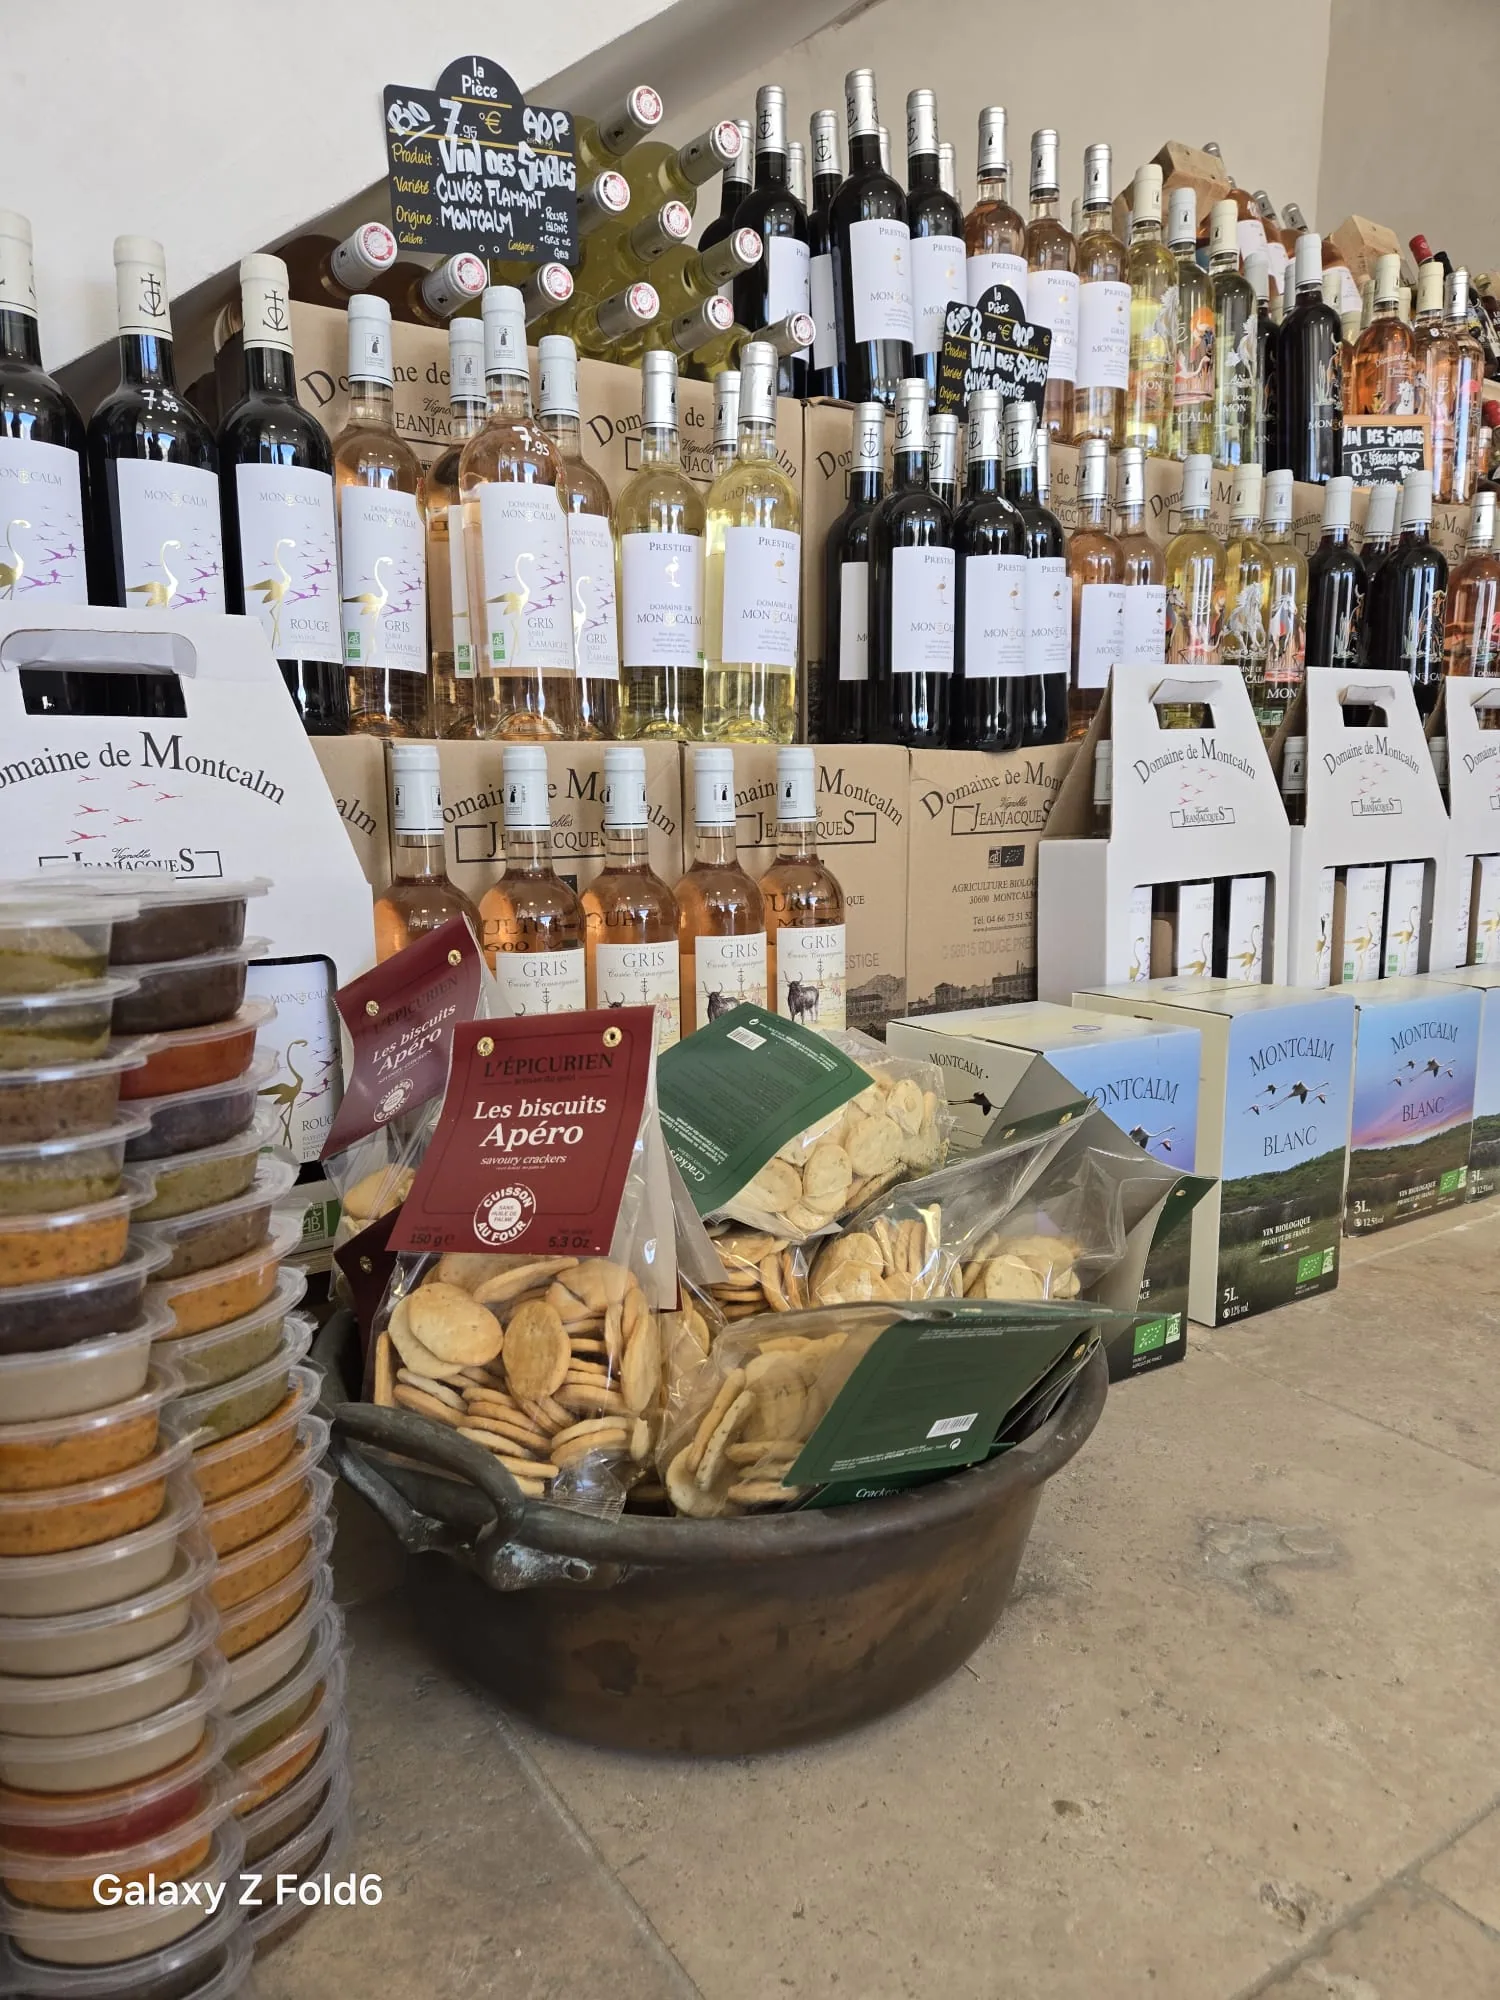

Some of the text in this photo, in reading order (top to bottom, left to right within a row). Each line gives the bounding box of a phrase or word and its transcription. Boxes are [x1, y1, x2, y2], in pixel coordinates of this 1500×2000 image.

[473, 57, 484, 78] la
[461, 75, 498, 98] Pièce
[522, 107, 570, 143] AOP
[391, 143, 433, 166] Produit
[517, 141, 576, 192] SABLES
[484, 179, 546, 217] FLAMANT
[395, 205, 513, 237] Origine MONTCALM
[987, 301, 1010, 315] Pièce
[299, 362, 450, 408] Done de
[939, 385, 961, 405] Origine
[685, 406, 705, 428] de
[1056, 468, 1070, 485] de
[1291, 513, 1322, 532] omaine
[649, 542, 693, 553] PRESTIGE
[758, 536, 796, 551] PRESTIGE
[650, 603, 683, 611] DOMAINE
[756, 599, 786, 611] DOMAINE
[290, 618, 330, 633] ROUGE
[384, 620, 411, 633] GRIS
[527, 617, 554, 630] GRIS
[586, 633, 608, 644] GRIS
[1132, 736, 1257, 785] Domaine de Montcalm
[1322, 734, 1420, 776] Domaine de Montcalm
[1462, 744, 1498, 774] Domaine
[99, 742, 132, 768] de
[139, 731, 286, 805] Montcalm
[816, 764, 904, 827] Montcalm
[919, 774, 1000, 821] Domaine
[1003, 768, 1021, 785] de
[951, 879, 1009, 894] AGRICULTURE
[986, 915, 996, 924] 04
[997, 915, 1006, 923] 66
[1015, 912, 1023, 921] 51
[1024, 911, 1033, 920] 52
[721, 942, 759, 959] GRIS
[801, 934, 837, 950] GRIS
[523, 959, 568, 978] GRIS
[622, 951, 665, 968] GRIS
[371, 1004, 457, 1064] Les biscuits
[1389, 1021, 1459, 1055] MONTCALM
[377, 1028, 442, 1075] Apéro
[1248, 1036, 1336, 1078] MONTCALM
[484, 1051, 614, 1078] L'ÉPICURIEN
[929, 1052, 984, 1079] MONTCALM
[473, 1095, 607, 1120] Les biscuits
[1401, 1096, 1446, 1123] BLANC
[301, 1116, 335, 1132] ROUG
[479, 1120, 584, 1153] Apéro
[1263, 1125, 1318, 1157] BLANC
[480, 1153, 568, 1167] savoury crackers
[483, 1186, 533, 1208] CUISSON
[477, 1220, 527, 1242] AU FOUR
[1275, 1216, 1312, 1234] BIOLOGIQUE
[434, 1234, 442, 1246] g
[571, 1236, 590, 1248] Oz
